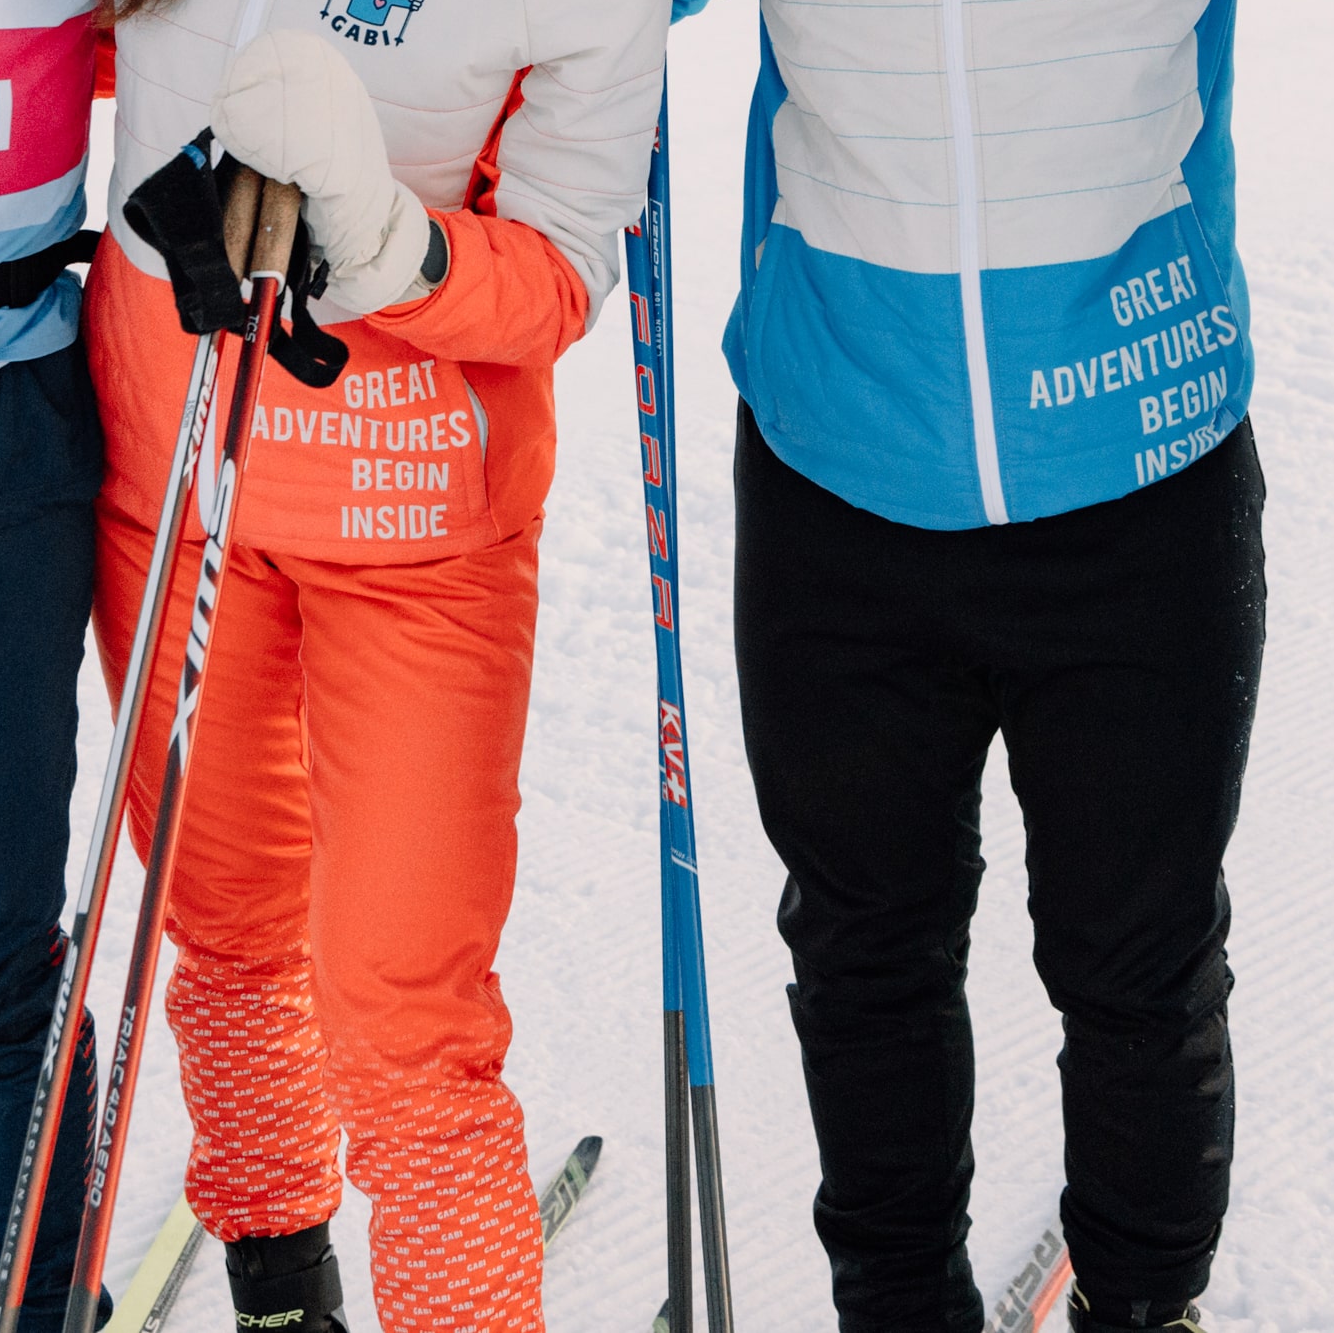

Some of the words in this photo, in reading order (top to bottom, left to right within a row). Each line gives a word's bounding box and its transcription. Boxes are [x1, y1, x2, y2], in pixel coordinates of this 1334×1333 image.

[330, 14, 392, 47] GABI
[1109, 254, 1198, 326] GREAT
[244, 315, 260, 344] TCS
[1030, 304, 1237, 409] ADVENTURES
[344, 360, 435, 409] GREAT
[1139, 366, 1227, 435] BEGIN
[182, 344, 219, 490] SWIX
[250, 409, 471, 452] ADVENTURES
[630, 291, 673, 632] FORZA
[352, 458, 448, 492] BEGIN
[341, 505, 447, 540] INSIDE
[169, 458, 236, 776] SWIX
[660, 698, 688, 809] KV+
[261, 983, 280, 991] GABI
[41, 939, 79, 1081] SWIX
[225, 1010, 245, 1018] GABI
[245, 1019, 264, 1027] GABI
[265, 1025, 284, 1034] GABI
[111, 1003, 136, 1085] TRIAC
[213, 1060, 231, 1068] GABI
[249, 1055, 267, 1064] GABI
[269, 1059, 287, 1070] GABI
[270, 1078, 287, 1088] GABI
[288, 1080, 306, 1092] GABI
[233, 1088, 254, 1097] GABI
[254, 1093, 273, 1104] GABI
[274, 1097, 293, 1108] GABI
[236, 1108, 256, 1118] GABI
[413, 1104, 434, 1116] GABI
[435, 1106, 453, 1119] GABI
[454, 1109, 472, 1122] GABI
[256, 1113, 276, 1124] GABI
[294, 1121, 311, 1131] GABI
[417, 1125, 437, 1136] GABI
[239, 1129, 258, 1137] GABI
[258, 1132, 278, 1143] GABI
[279, 1136, 299, 1147] GABI
[242, 1148, 263, 1156] GABI
[450, 1146, 471, 1159] GABI
[409, 1157, 430, 1167] GABI
[89, 1129, 111, 1209] AERO
[245, 1163, 265, 1173] GABI
[431, 1164, 453, 1174] GABI
[265, 1169, 285, 1179] GABI
[285, 1174, 303, 1183] GABI
[247, 1184, 268, 1193] GABI
[413, 1180, 435, 1191] GABI
[436, 1187, 458, 1196] GABI
[474, 1194, 492, 1207] GABI
[493, 1199, 512, 1212] GABI
[227, 1208, 249, 1216] GABI
[267, 1203, 287, 1211] GABI
[437, 1207, 458, 1220] GABI
[460, 1212, 480, 1225] GABI
[268, 1216, 288, 1224] GABI
[479, 1218, 499, 1230] GABI
[417, 1224, 440, 1234] GABI
[441, 1230, 463, 1242] GABI
[464, 1236, 485, 1248] GABI
[424, 1247, 445, 1256] GABI
[501, 1246, 518, 1258] GABI
[407, 1260, 427, 1268] GABI
[445, 1254, 466, 1265] GABI
[467, 1259, 486, 1272] GABI
[486, 1264, 504, 1277] GABI
[425, 1270, 448, 1280] GABI
[506, 1269, 524, 1282] GABI
[447, 1278, 470, 1289] GABI
[469, 1283, 489, 1296] GABI
[428, 1294, 451, 1304] GABI
[451, 1301, 474, 1312] GABI
[432, 1316, 455, 1326] GABI
